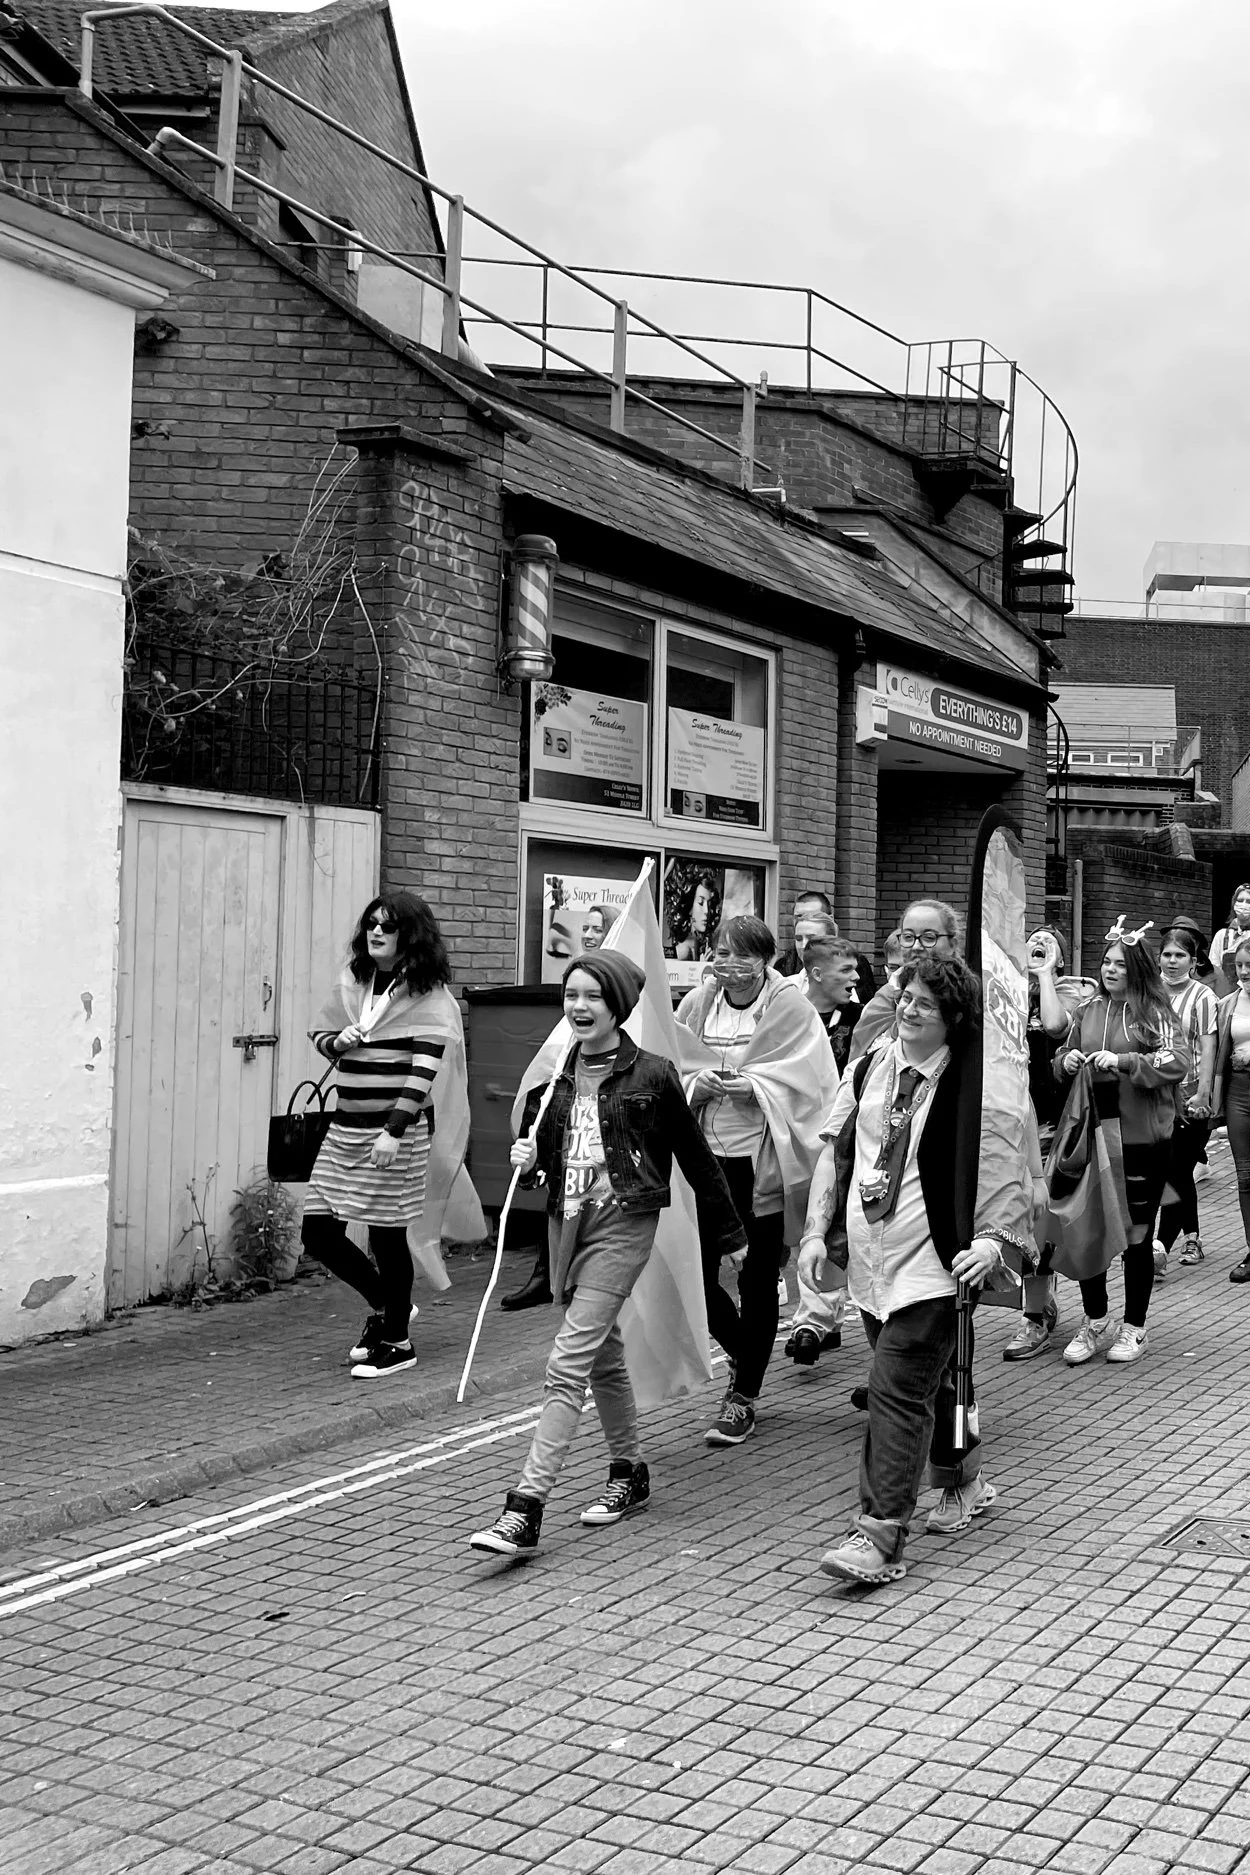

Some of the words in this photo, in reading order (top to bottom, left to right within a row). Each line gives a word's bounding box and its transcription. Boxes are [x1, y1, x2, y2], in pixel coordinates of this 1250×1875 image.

[597, 701, 619, 715] Super
[939, 695, 1000, 730] EVERYTHING'S
[1002, 715, 1017, 734] £14
[589, 714, 626, 734] Threading
[692, 719, 710, 731] Super
[713, 723, 742, 740] Threading
[910, 721, 921, 735] NO
[922, 727, 974, 750] APPOINTMENT
[975, 741, 1002, 758] NEEDED
[573, 887, 597, 904] Super
